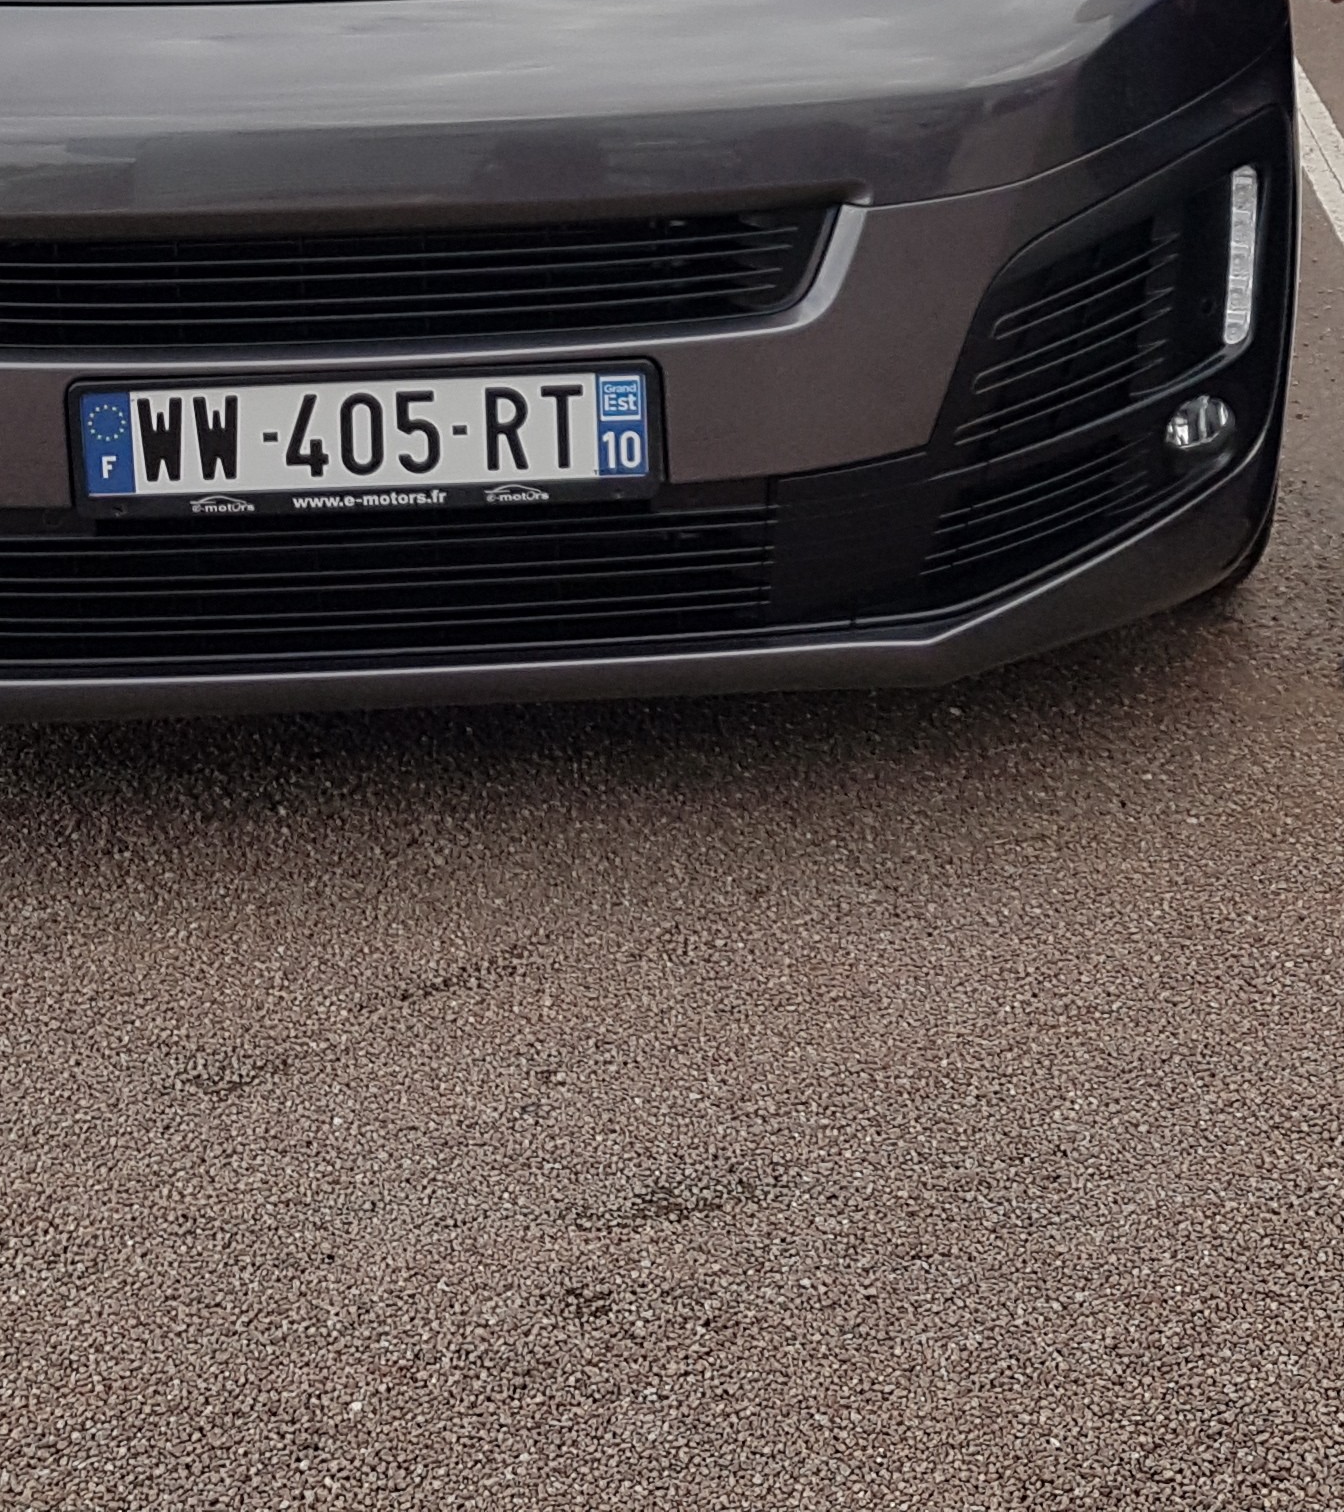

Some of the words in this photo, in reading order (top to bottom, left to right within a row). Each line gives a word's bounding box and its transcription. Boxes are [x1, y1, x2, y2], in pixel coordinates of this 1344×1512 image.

[603, 384, 637, 394] Grand
[604, 394, 637, 411] Est
[137, 384, 584, 482] WW-405-RT
[602, 430, 642, 469] 10
[102, 456, 117, 478] F
[292, 489, 448, 509] www.e-motors.fr
